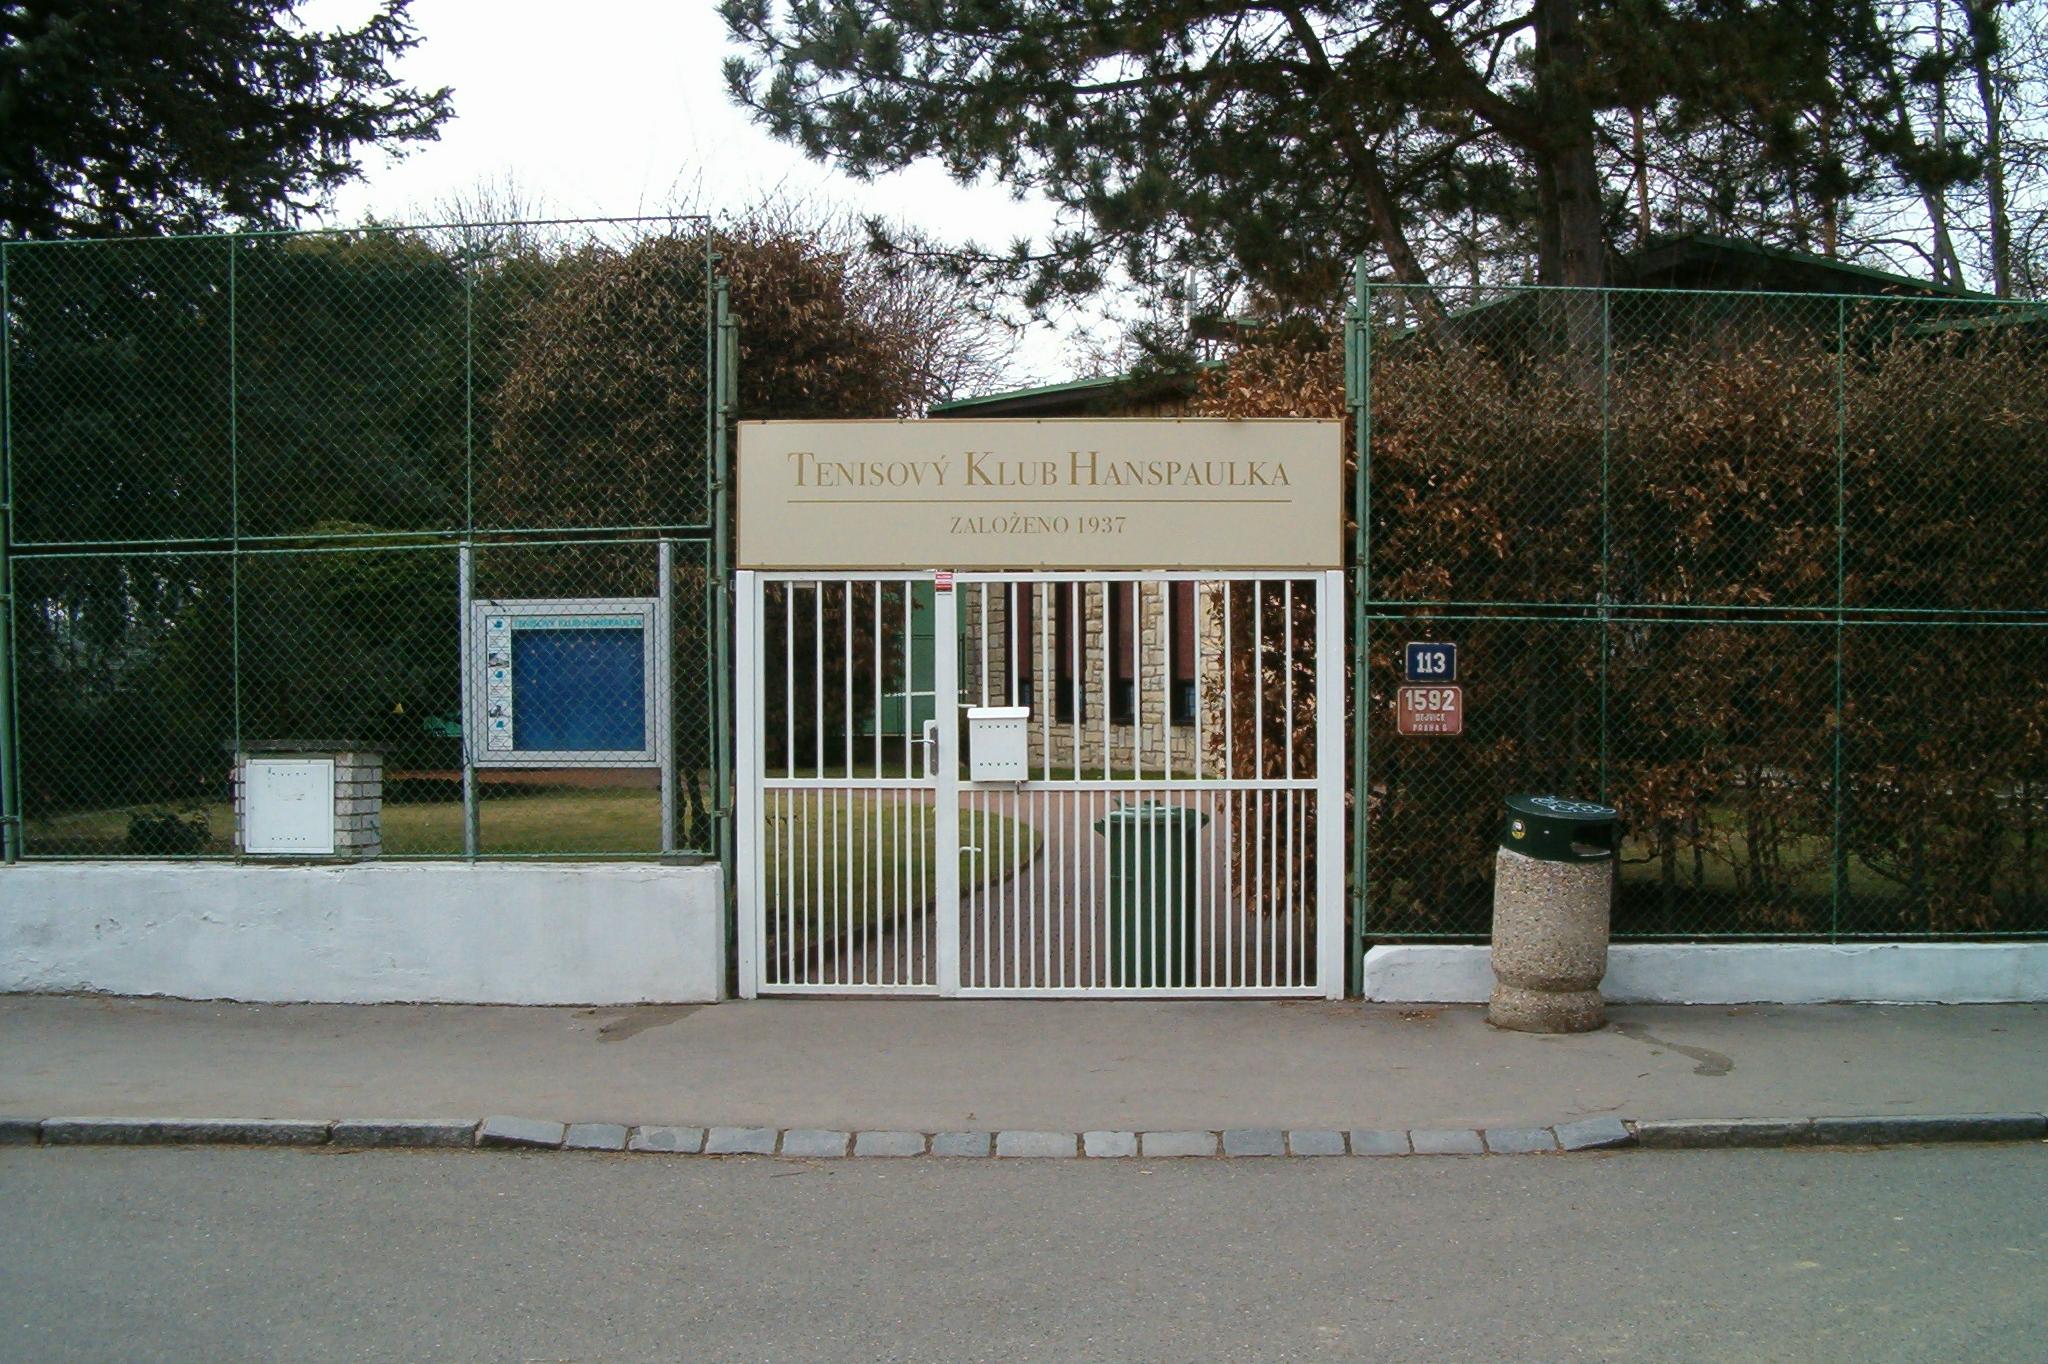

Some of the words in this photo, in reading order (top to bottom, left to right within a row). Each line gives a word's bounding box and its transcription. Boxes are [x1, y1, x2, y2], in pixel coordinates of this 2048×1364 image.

[787, 452, 950, 487] TENISOVÝ
[964, 451, 1057, 486] KLUB
[1067, 451, 1291, 486] HANSPAULKA
[949, 512, 1069, 534] ZALOŽENO
[1078, 516, 1126, 534] 1937
[1416, 652, 1446, 673] 113
[1405, 689, 1455, 711] 1592
